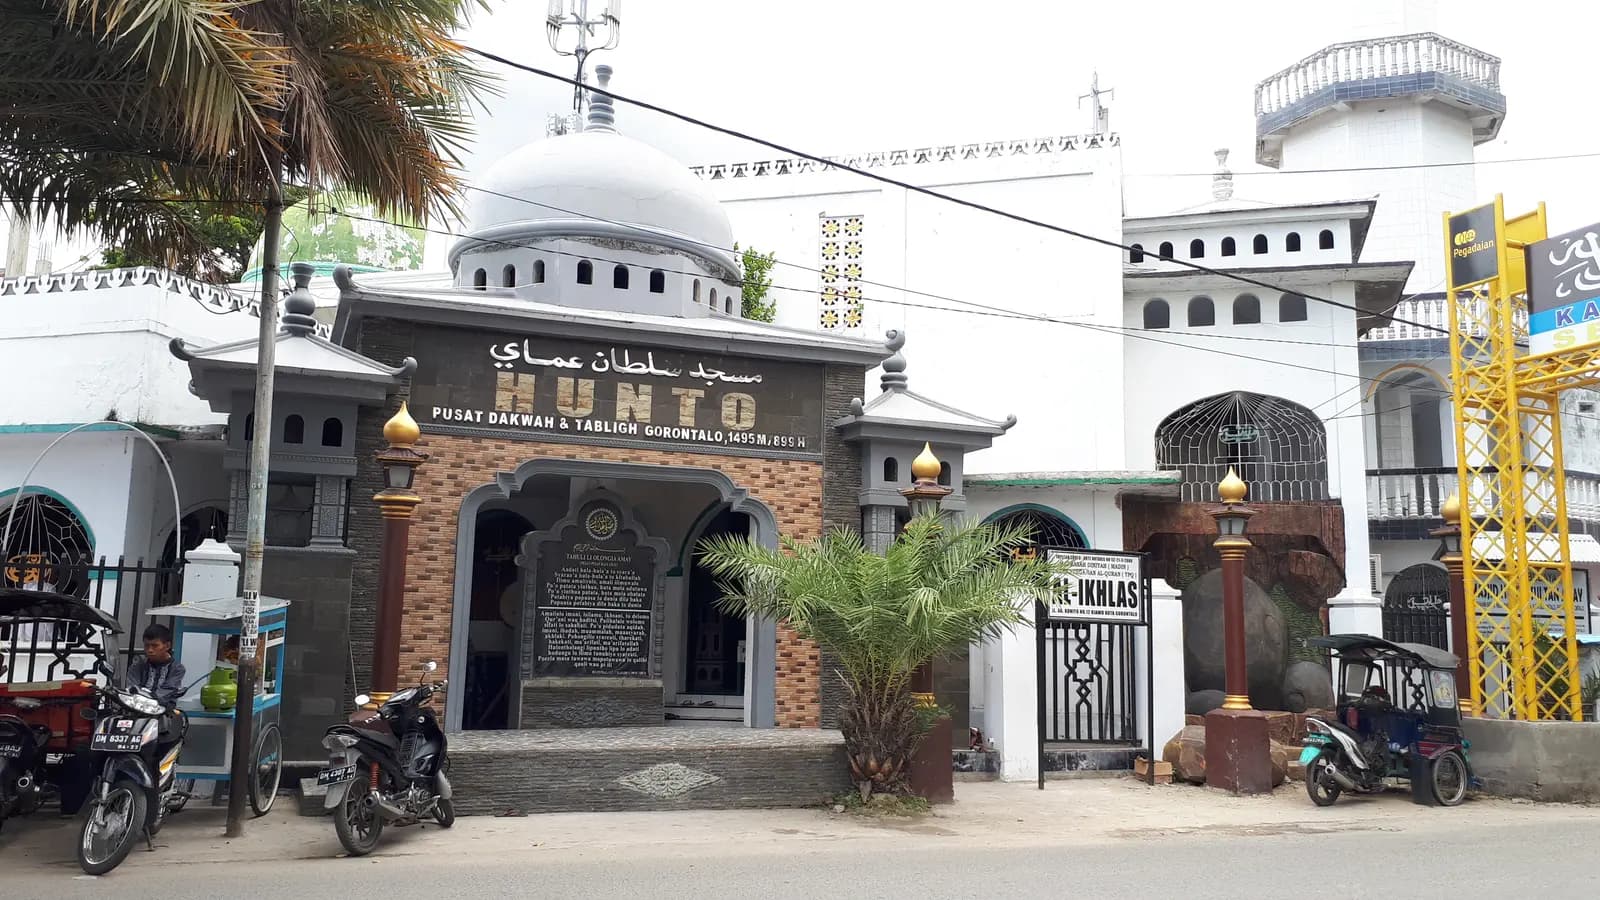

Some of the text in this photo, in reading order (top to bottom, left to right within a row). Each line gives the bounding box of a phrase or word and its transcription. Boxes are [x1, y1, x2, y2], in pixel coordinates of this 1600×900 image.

[1454, 240, 1494, 258] Pegadaian
[489, 338, 763, 386] مسجد سلطان عماي
[494, 370, 757, 432] HUNTO
[432, 406, 484, 423] PUSAT
[488, 411, 554, 429] DAKWAH
[559, 417, 569, 430] &
[575, 418, 638, 435] TABLIGH
